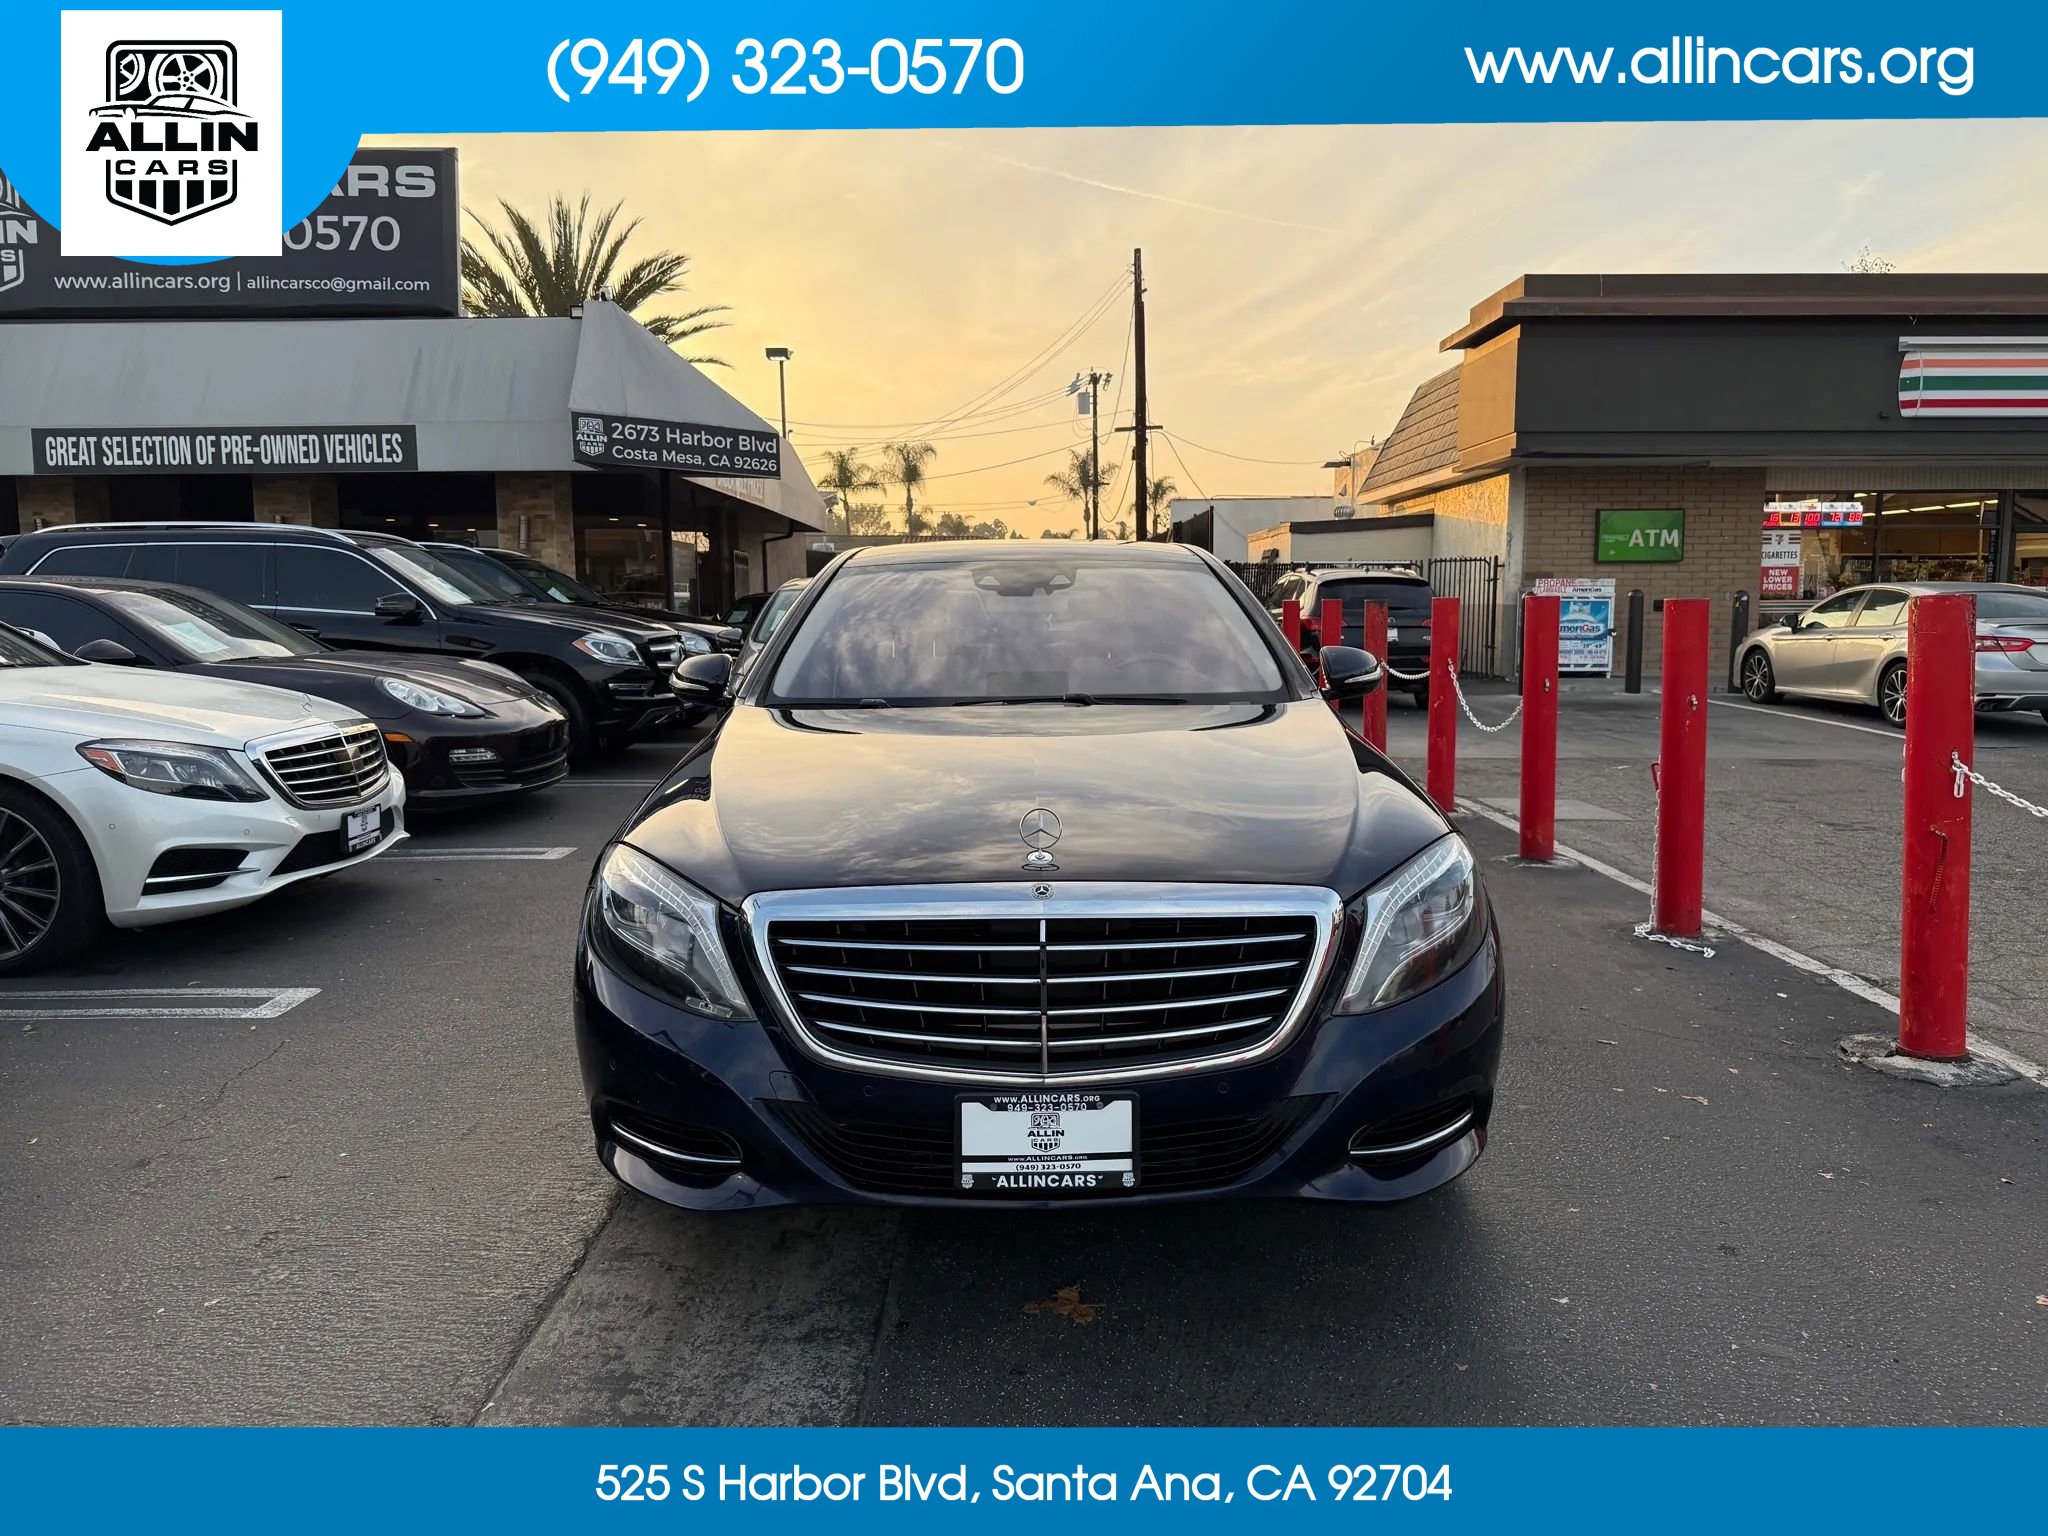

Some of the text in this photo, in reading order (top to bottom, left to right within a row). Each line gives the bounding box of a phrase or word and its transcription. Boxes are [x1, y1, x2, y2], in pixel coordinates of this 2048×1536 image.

[54, 271, 430, 293] www.allincars.org allincarsco@gmail.com
[576, 433, 608, 443] ALLIN
[611, 422, 777, 454] 2673 Harbor Blvd
[45, 433, 403, 467] GREAT SELECTION OF PRE-OWNED VEHICLES
[612, 445, 777, 472] Costa Mesa, CA 92626
[1628, 528, 1679, 548] ATM
[1761, 550, 1798, 560] CIGARETTES
[1538, 579, 1576, 587] PROPANE
[1762, 583, 1793, 591] PRICES
[1560, 624, 1601, 633] meriGas
[1007, 1102, 1088, 1112] 949-323-0570
[1027, 1129, 1065, 1138] ALLIN
[1015, 1162, 1082, 1171] (949) 323-0570
